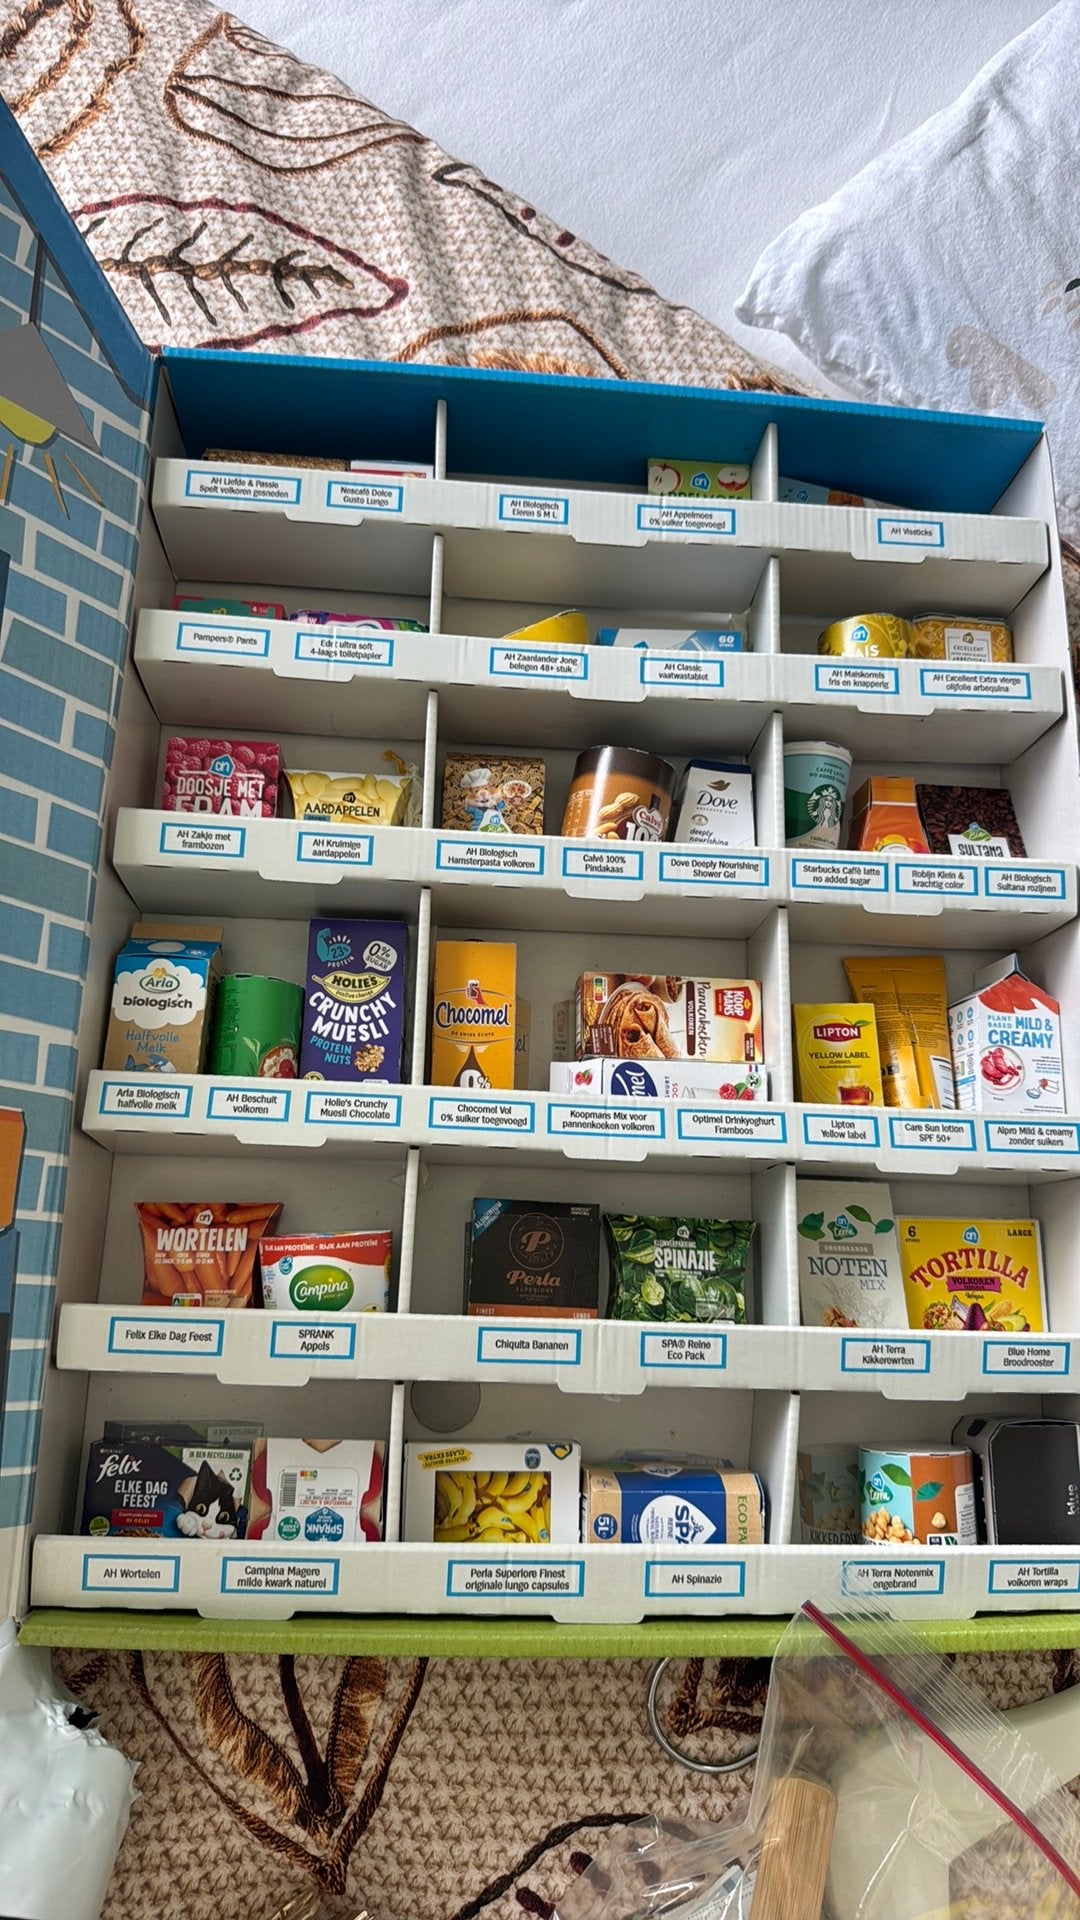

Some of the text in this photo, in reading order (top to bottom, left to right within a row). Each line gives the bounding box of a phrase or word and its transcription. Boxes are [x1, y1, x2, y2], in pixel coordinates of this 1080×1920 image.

[177, 776, 265, 798] DOOSJE MET
[696, 792, 737, 808] Dove
[304, 802, 380, 817] AARDAPPELEN
[182, 841, 224, 851] frambozen
[312, 849, 360, 858] aardappelen
[448, 856, 535, 868] Hamsterpasta volkoren
[671, 859, 758, 872] Dove Deeply Nourishing
[585, 863, 623, 873] Pindakaas
[803, 865, 840, 874] Starbucks
[842, 866, 862, 875] Caffè
[693, 870, 736, 878] Shower Gel
[825, 875, 848, 884] added
[850, 877, 870, 886] sugar
[912, 879, 964, 890] krachtig color
[997, 884, 1056, 894] Sultana rozijnen
[145, 977, 174, 988] Arla
[332, 975, 377, 988] HOLIE'S
[123, 996, 192, 1010] biologisch
[309, 991, 396, 1023] CRUNCHY
[436, 1001, 511, 1028] Chocomel
[311, 1016, 389, 1042] MUESLI
[1016, 1017, 1053, 1031] MILD &
[126, 1030, 180, 1042] Halfvolle
[817, 1028, 858, 1037] LIPTON
[988, 1030, 1053, 1048] CREAMY
[136, 1041, 165, 1053] Melk
[310, 1036, 352, 1054] PROTEIN
[325, 1053, 350, 1065] NUTS
[117, 1088, 180, 1100] Arla Biologisch
[227, 1094, 277, 1104] AH Beschuit
[117, 1099, 176, 1110] halfvolle melk
[233, 1104, 269, 1114] volkoren
[324, 1099, 388, 1110] Holie's Crunchy
[457, 1104, 511, 1114] Chocomel Vol
[320, 1108, 390, 1119] Muesli Chocolate
[570, 1111, 611, 1121] Koopmans
[614, 1112, 628, 1120] Mix
[441, 1114, 527, 1126] 0% suiker toegevoegd
[563, 1120, 655, 1131] pannenkoeken volkoren
[692, 1115, 775, 1127] Optimel Drinkyoghurt
[831, 1120, 855, 1130] Lipton
[715, 1126, 754, 1135] Framboos
[905, 1123, 964, 1133] Care Sun lotion
[997, 1127, 1017, 1136] Alpro
[1019, 1127, 1035, 1135] Mild
[1046, 1129, 1073, 1138] creamy
[821, 1130, 866, 1139] Yellow label
[919, 1134, 951, 1142] SPF 50+
[1009, 1137, 1064, 1146] zonder suikers
[475, 1201, 502, 1228] ALUMINIUM
[908, 1226, 916, 1237] 6
[157, 1228, 248, 1252] WORTELEN
[655, 1248, 716, 1271] SPINAZIE
[808, 1257, 888, 1277] NOTEN
[909, 1248, 1029, 1288] TORTILLA
[506, 1270, 560, 1286] Perla
[295, 1278, 348, 1302] Campina
[860, 1280, 886, 1290] MIX
[126, 1330, 212, 1342] Felix Elke Dag Feest
[299, 1329, 334, 1339] SPRANK
[300, 1341, 330, 1351] Appels
[495, 1339, 569, 1350] Chiquita Bananen
[662, 1339, 711, 1349] SPA® Reine
[872, 1345, 883, 1353] AH
[668, 1351, 705, 1360] Eco Pack
[1008, 1348, 1050, 1356] Blue Home
[1004, 1358, 1054, 1367] Broodrooster
[96, 1454, 142, 1483] felix
[115, 1480, 168, 1494] ELKE DAG
[123, 1494, 158, 1508] FEEST
[104, 1569, 160, 1579] AH Wortelen
[245, 1566, 320, 1577] Campina Magere
[471, 1569, 565, 1580] Perla Superiore Finest
[858, 1569, 934, 1578] AH Terra Notenmix
[1018, 1567, 1059, 1576] AH Tortilla
[237, 1576, 326, 1588] milde kwark naturel
[672, 1574, 722, 1585] AH Spinazie
[873, 1579, 916, 1589] ongebrand
[1007, 1577, 1068, 1588] volkoren wraps
[465, 1580, 569, 1591] originale lungo capsules
